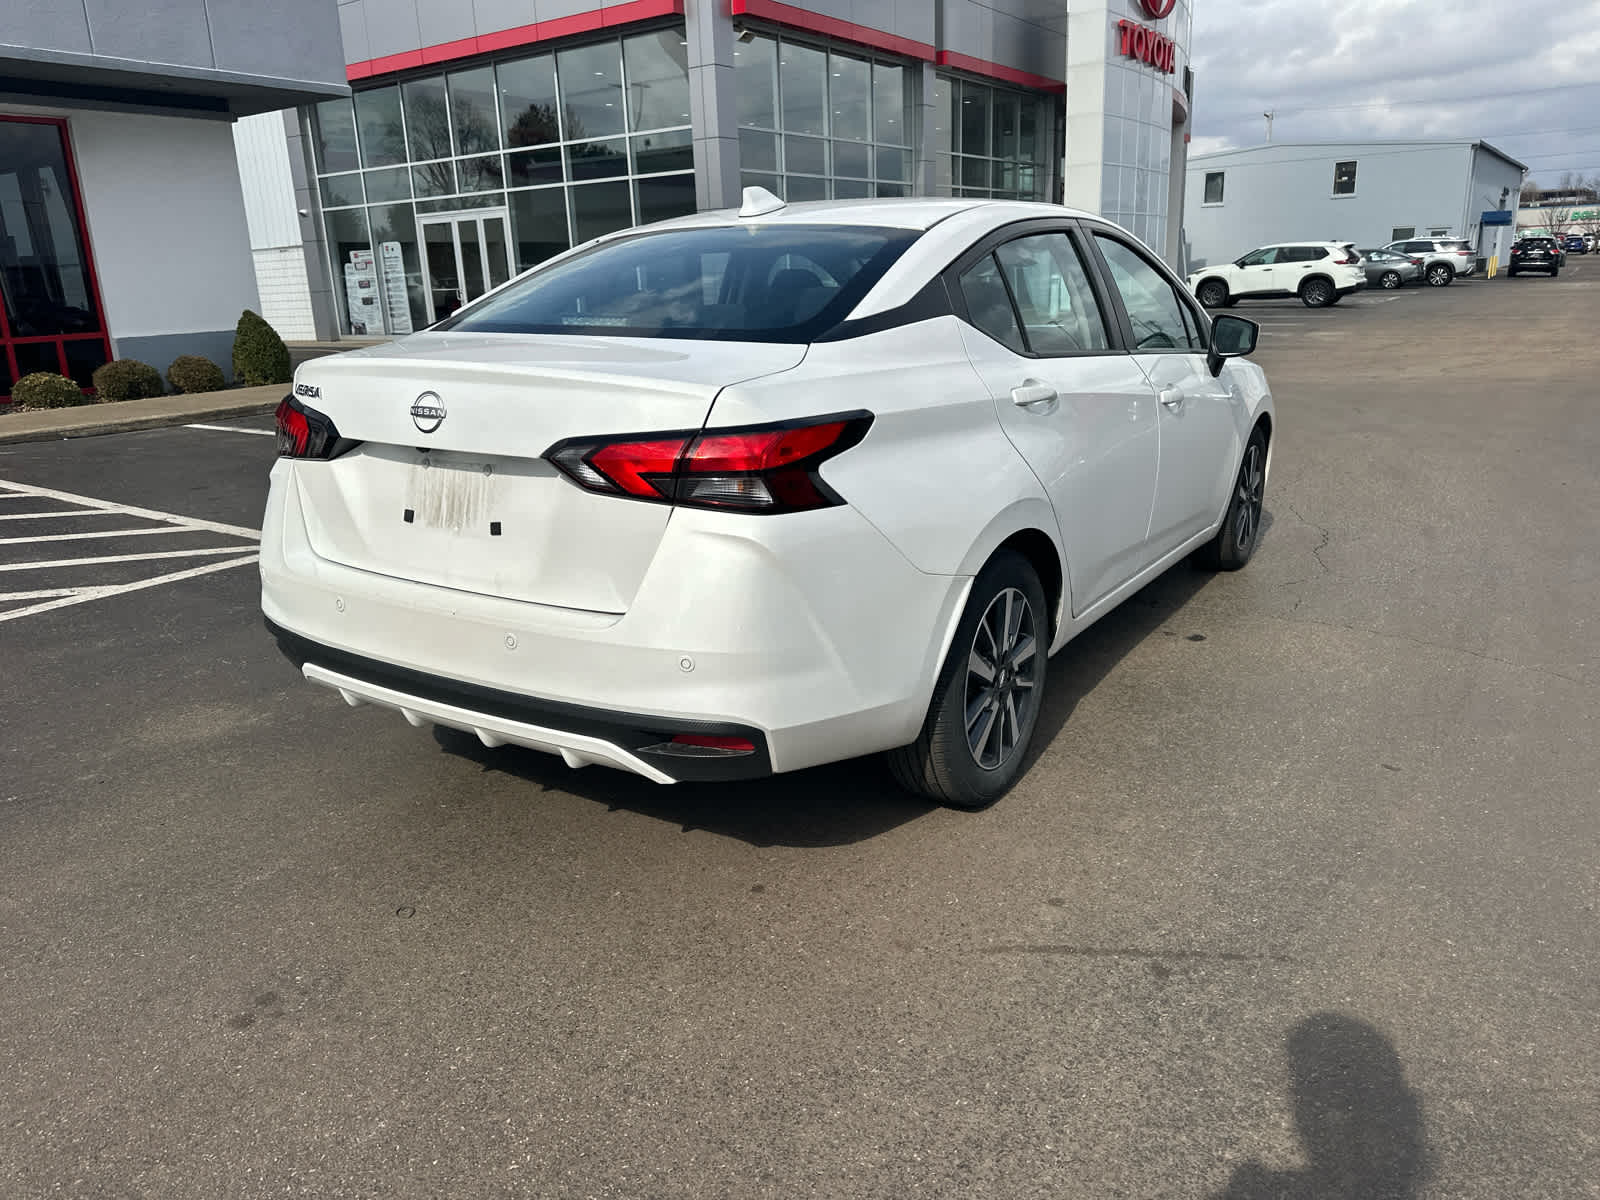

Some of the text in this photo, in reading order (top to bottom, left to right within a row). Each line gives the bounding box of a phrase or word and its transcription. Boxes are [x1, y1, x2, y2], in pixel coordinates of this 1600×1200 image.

[1118, 19, 1175, 74] TOYOTA
[295, 384, 321, 399] VERSA
[410, 407, 446, 418] NISSAN
